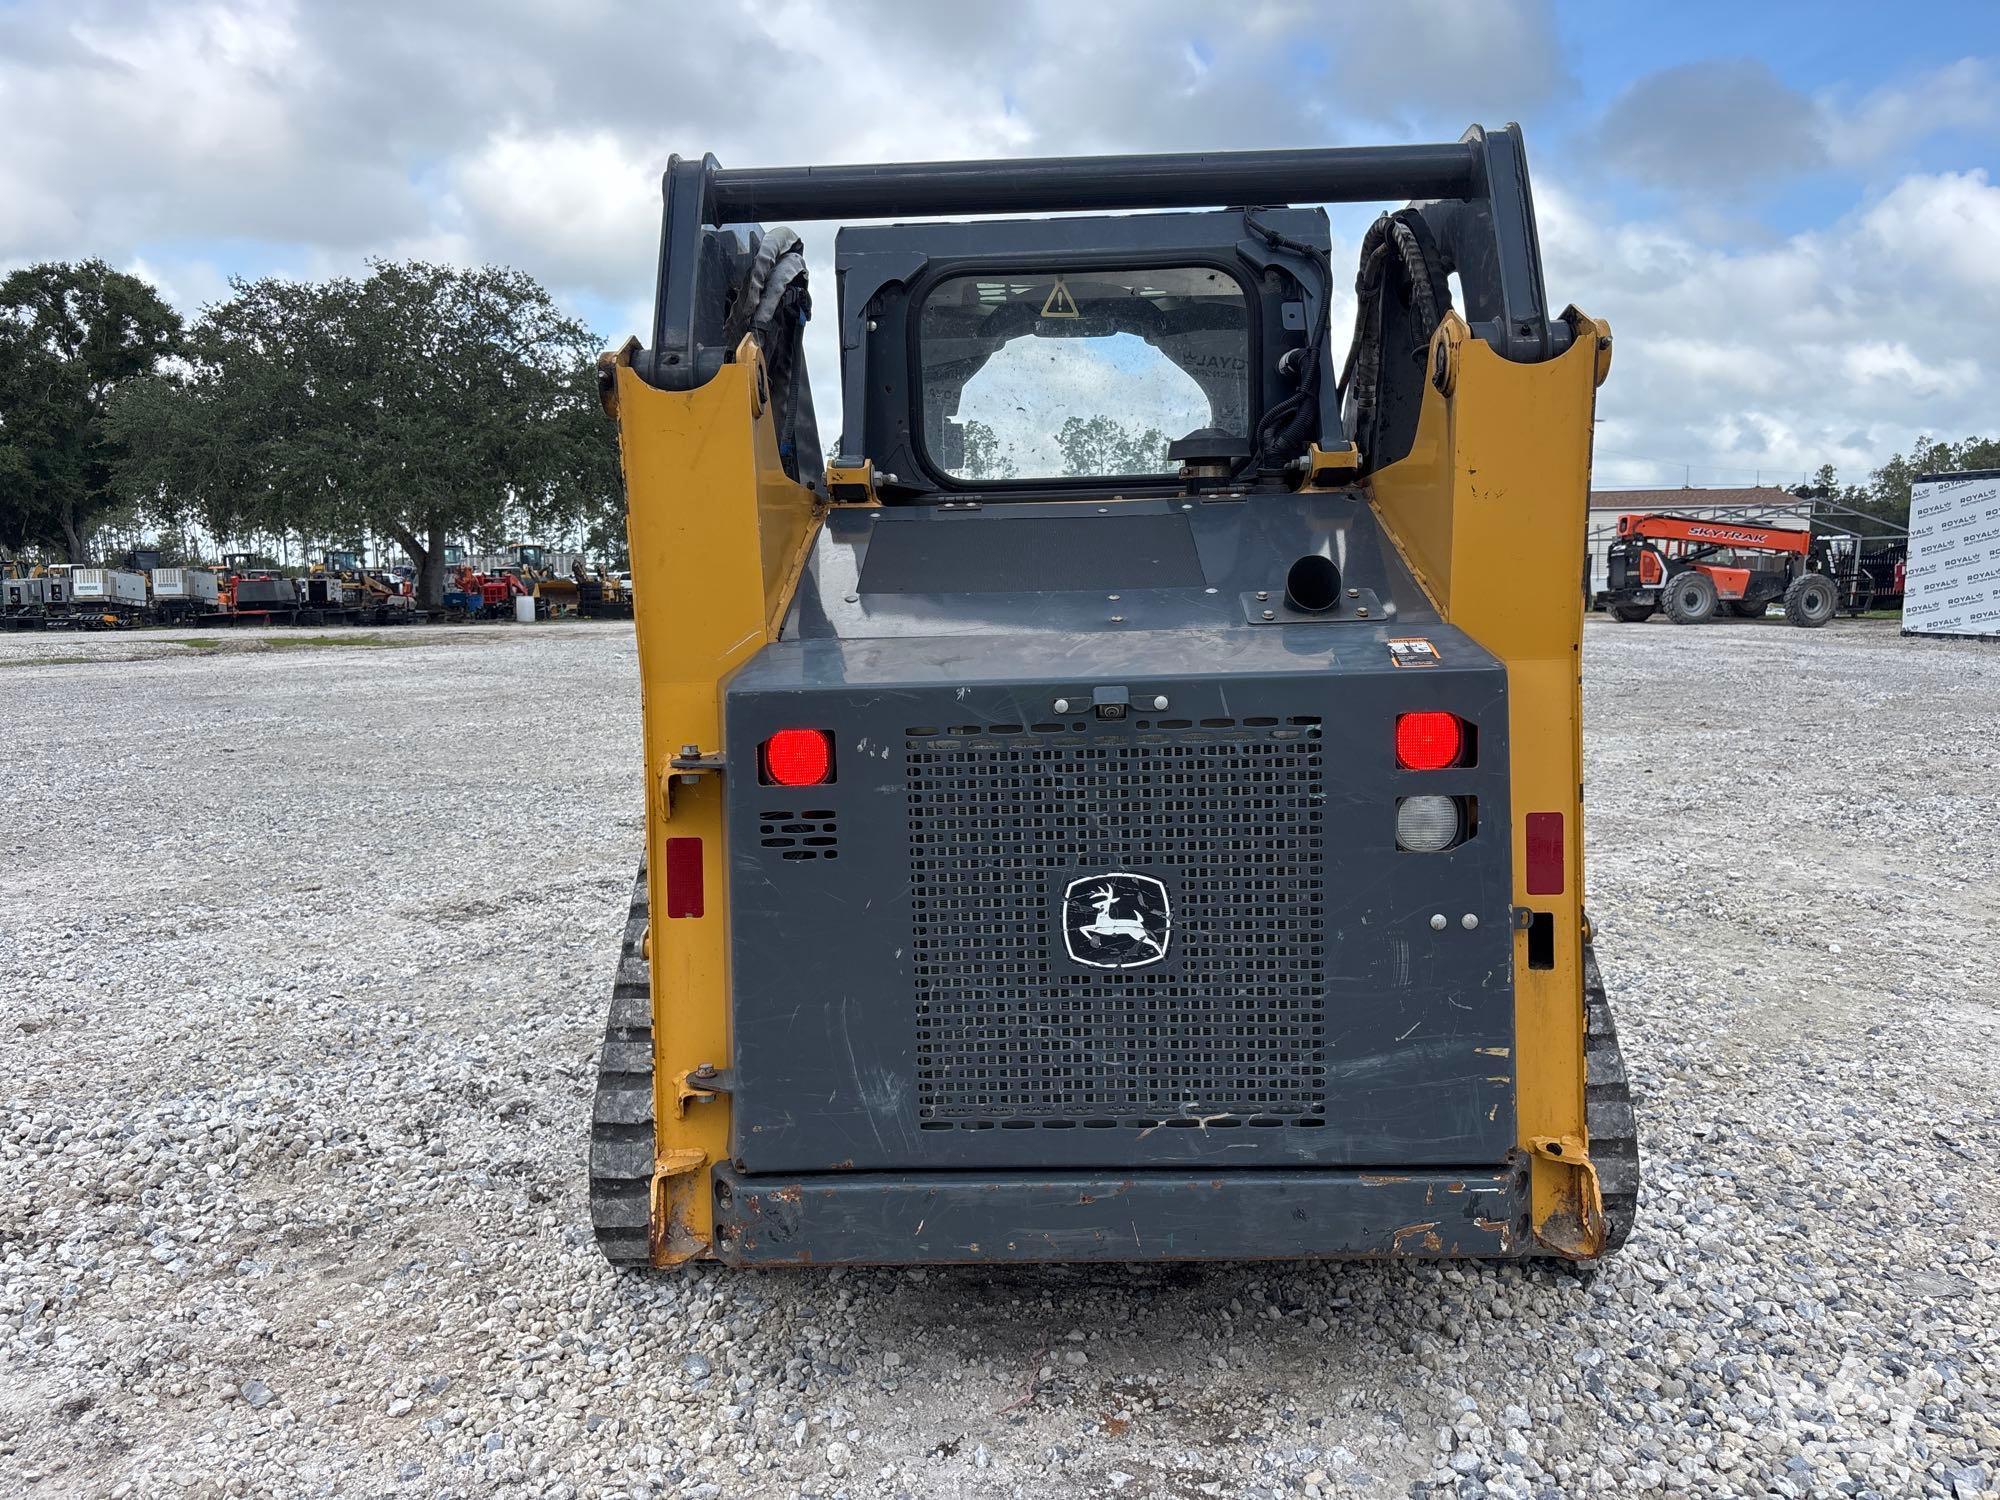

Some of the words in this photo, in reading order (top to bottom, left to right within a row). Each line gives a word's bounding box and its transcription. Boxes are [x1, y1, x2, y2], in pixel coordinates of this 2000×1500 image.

[1960, 492, 1988, 504] ROYAL
[1918, 504, 1944, 515] ROYAL
[1942, 517, 1969, 528] ROYAL
[1688, 527, 1768, 544] SKYTRAK
[1964, 531, 1992, 542] ROYAL
[1921, 542, 1947, 553] ROYAL
[1944, 556, 1972, 566] ROYAL
[1906, 566, 1930, 575] OYAL
[1967, 571, 1995, 581] ROYAL
[1924, 580, 1951, 590] ROYAL
[1948, 594, 1976, 605] ROYAL
[1906, 603, 1933, 613] ROYAL
[1970, 610, 1999, 620] ROYAL
[1926, 618, 1954, 628] ROYAL
